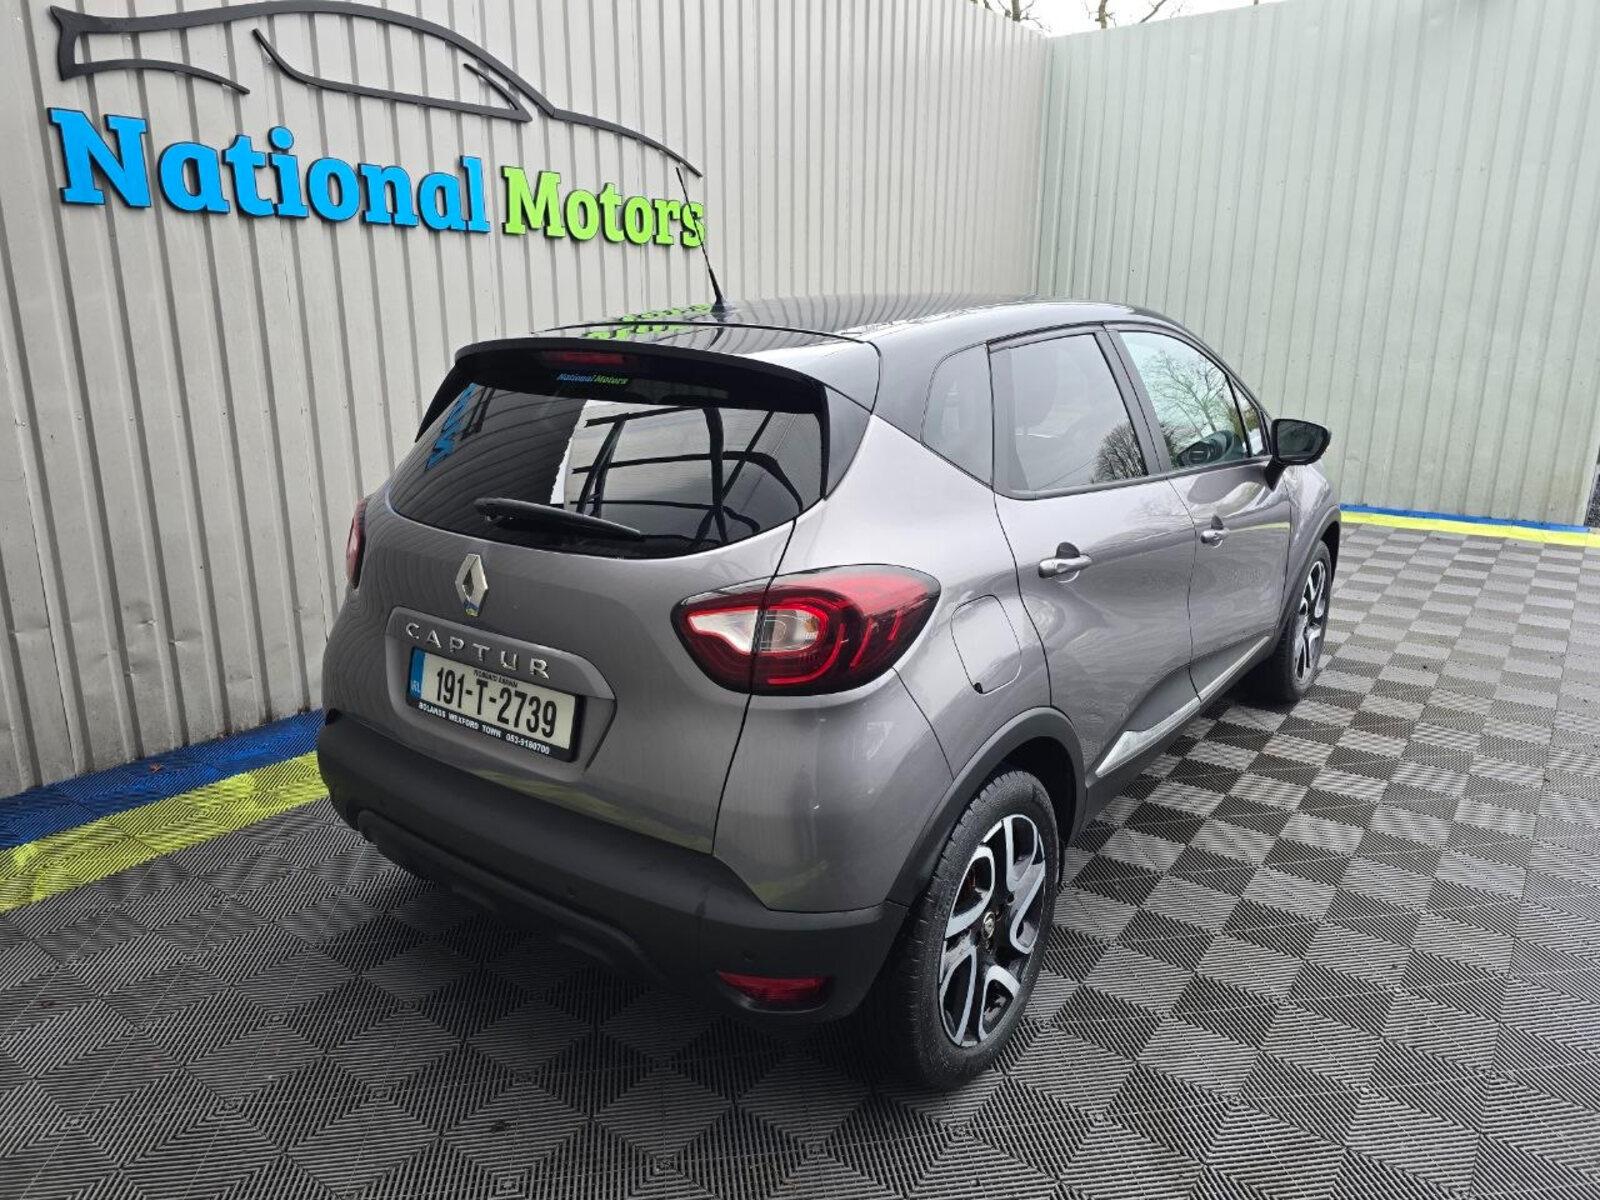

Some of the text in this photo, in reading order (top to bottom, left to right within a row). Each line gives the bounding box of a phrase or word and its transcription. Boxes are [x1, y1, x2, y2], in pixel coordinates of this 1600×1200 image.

[48, 107, 705, 249] National Motors
[405, 622, 550, 680] CAPTUR
[436, 666, 558, 739] 191-T-2739
[448, 712, 479, 730] WEXFORD
[482, 724, 502, 738] TOWN
